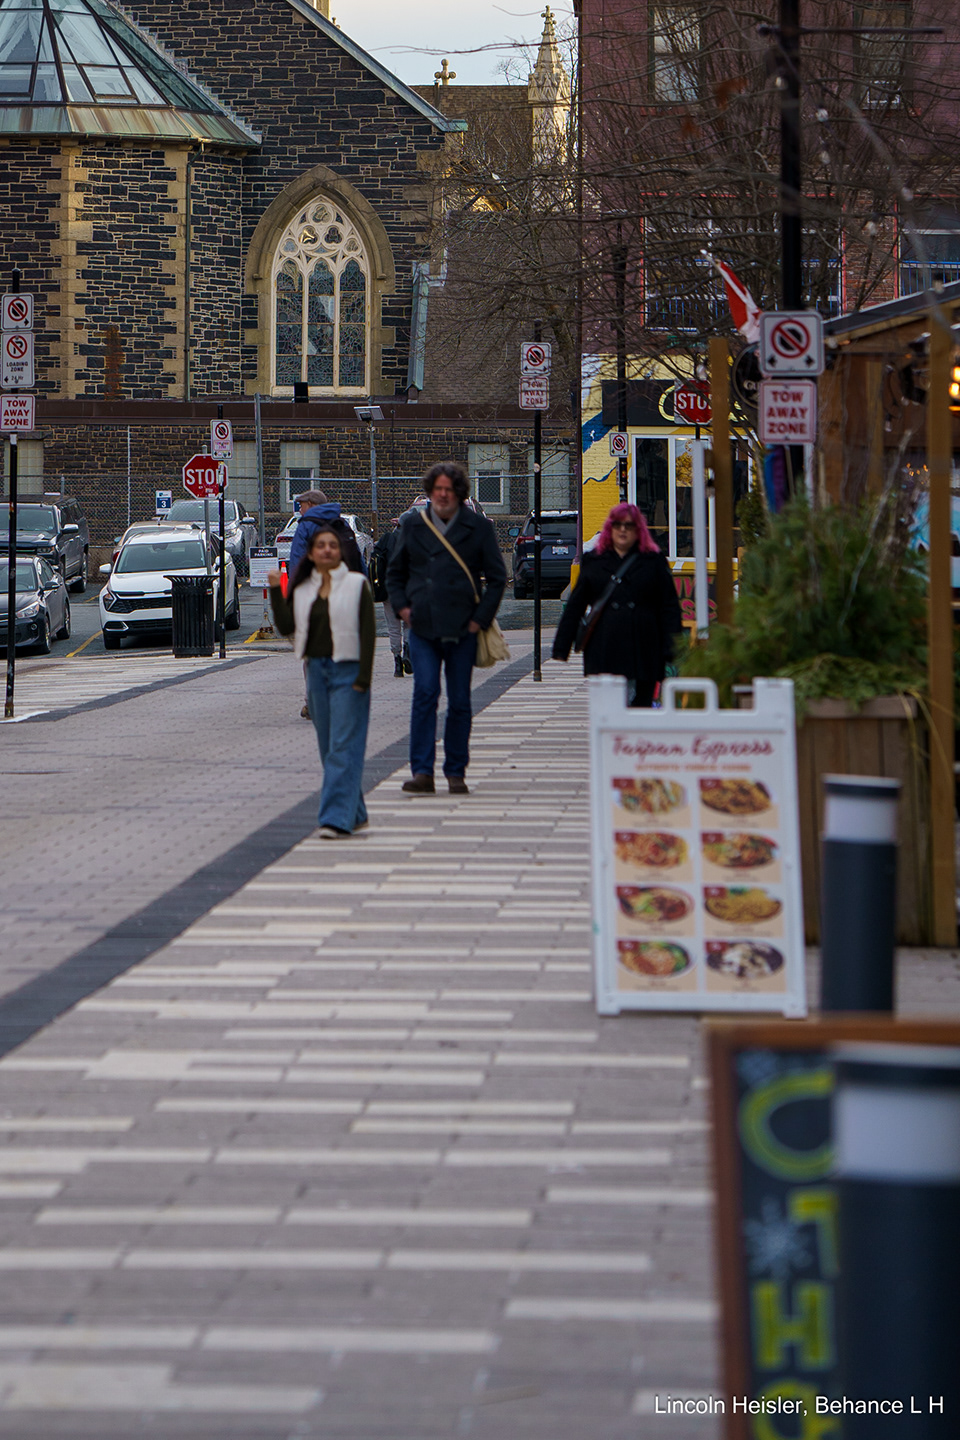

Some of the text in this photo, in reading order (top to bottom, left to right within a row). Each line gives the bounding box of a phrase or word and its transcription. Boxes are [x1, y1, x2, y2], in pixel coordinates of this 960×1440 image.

[771, 391, 804, 403] TOW
[3, 409, 30, 417] AWAY
[767, 408, 808, 419] AWAY
[768, 423, 807, 434] ZONE
